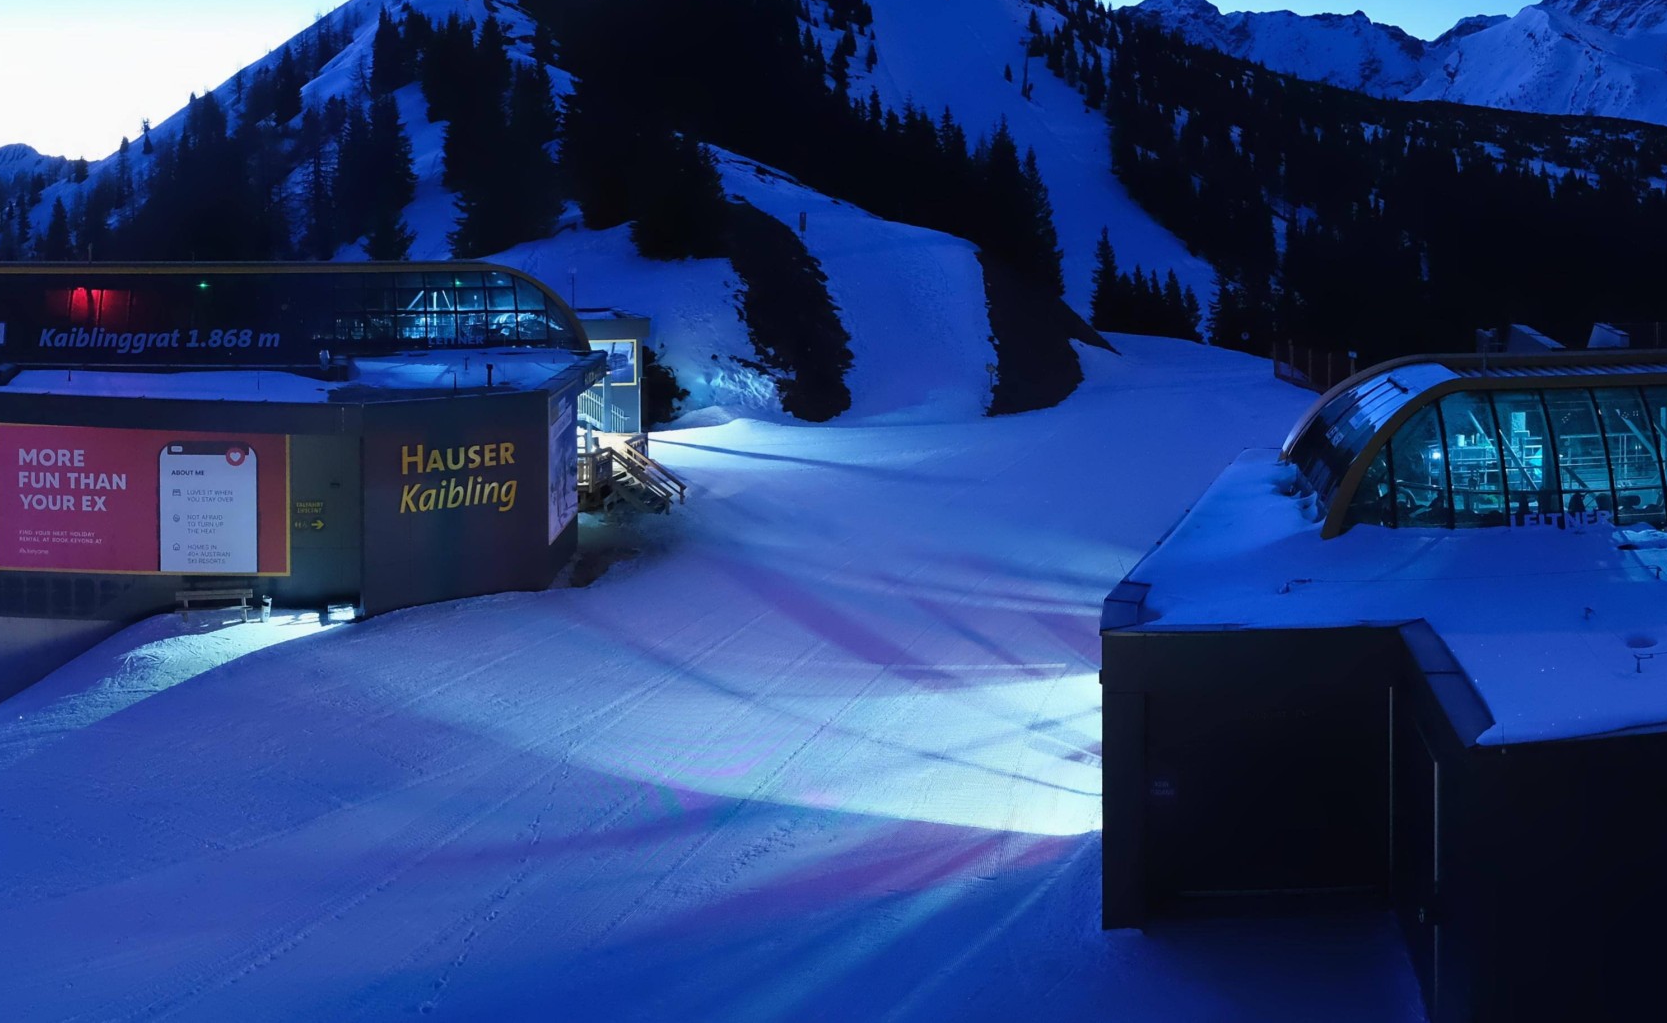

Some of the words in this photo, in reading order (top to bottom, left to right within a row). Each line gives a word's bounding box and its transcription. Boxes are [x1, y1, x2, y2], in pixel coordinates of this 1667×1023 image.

[39, 327, 180, 354] Kaiblinggrat
[186, 328, 252, 348] 1.868
[258, 333, 280, 347] m
[428, 336, 484, 345] LEITNER
[18, 448, 85, 467] MORE
[402, 442, 515, 474] HAUSER
[18, 471, 60, 488] FUN
[66, 473, 127, 490] THAN
[19, 494, 75, 511] YOUR
[81, 496, 107, 512] EX
[400, 476, 517, 513] Kaibling
